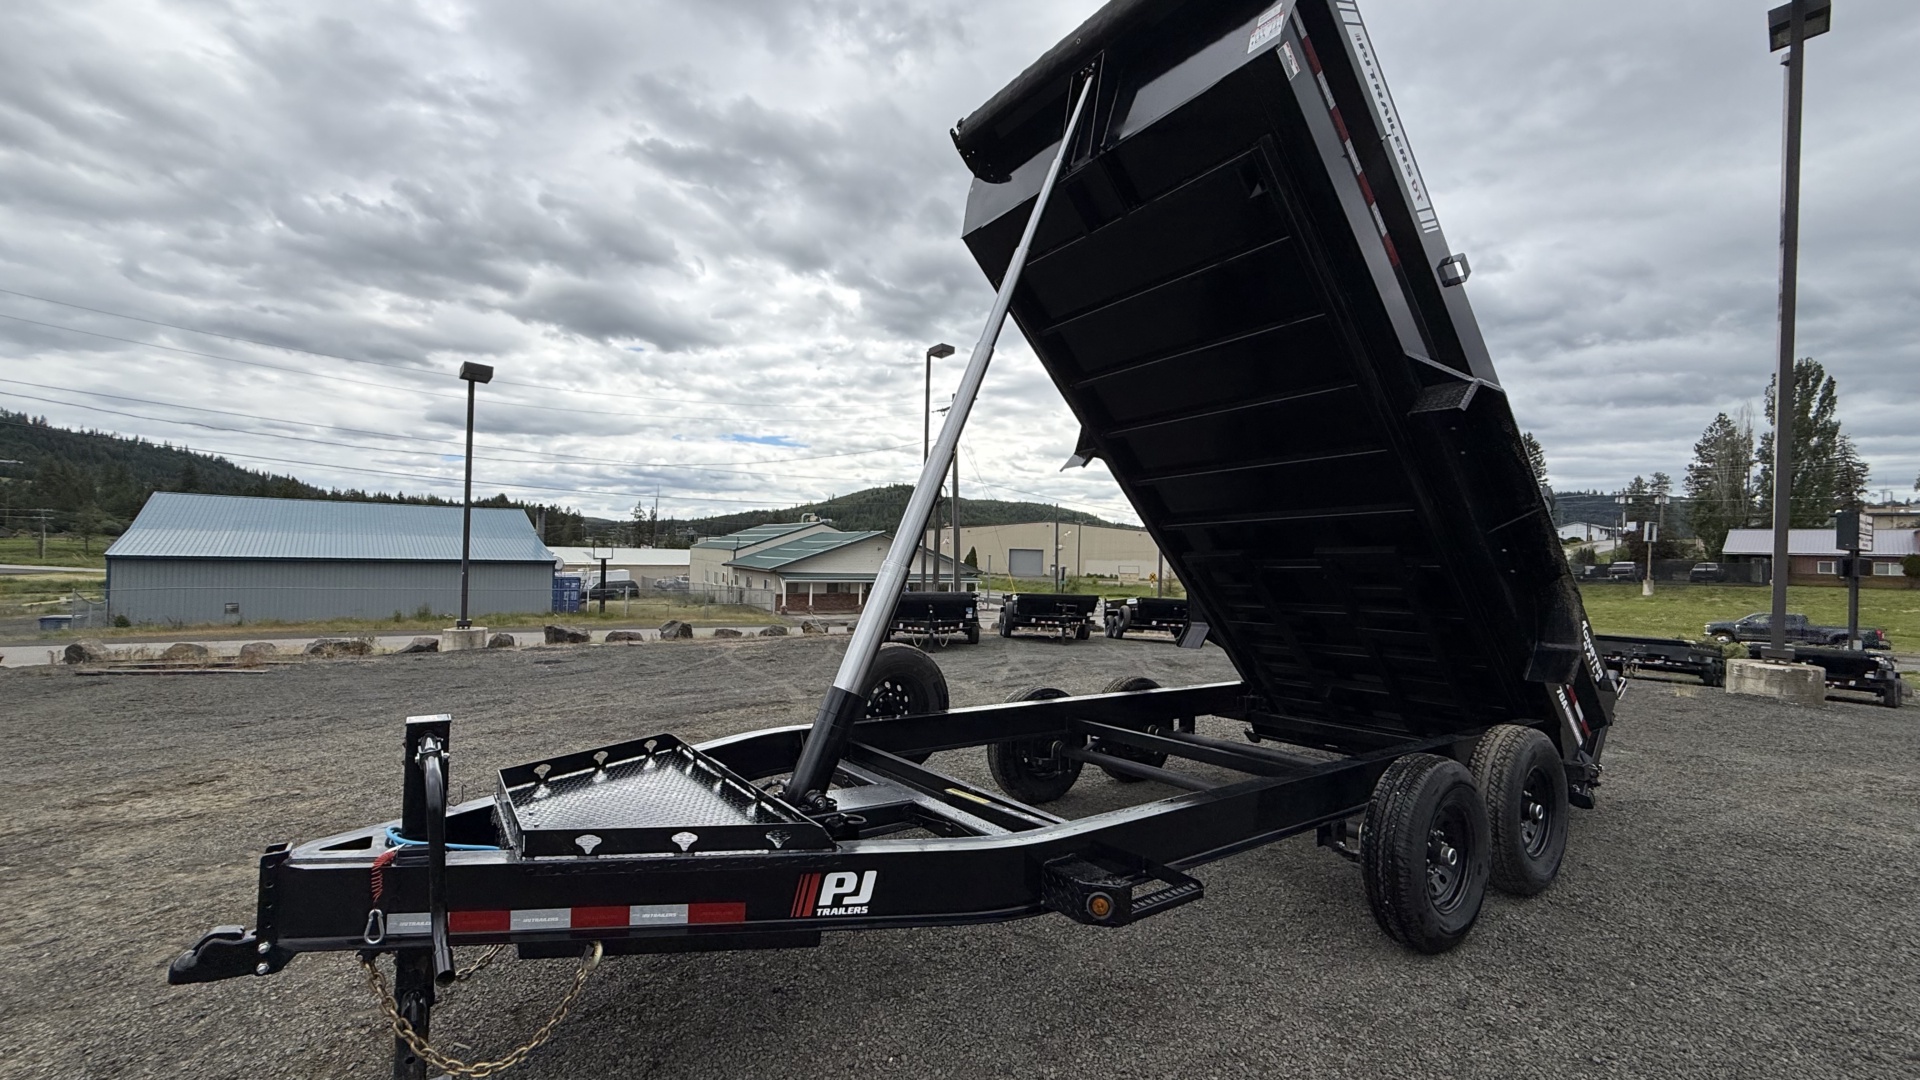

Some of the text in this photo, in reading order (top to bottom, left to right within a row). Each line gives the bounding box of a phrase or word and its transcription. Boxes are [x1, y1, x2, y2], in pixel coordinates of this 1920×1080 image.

[1369, 68, 1414, 177] TRAILERS
[1582, 620, 1604, 679] MONSTER
[1582, 641, 1600, 682] RAILS
[818, 870, 878, 906] PJ
[816, 905, 869, 917] TRAILERS
